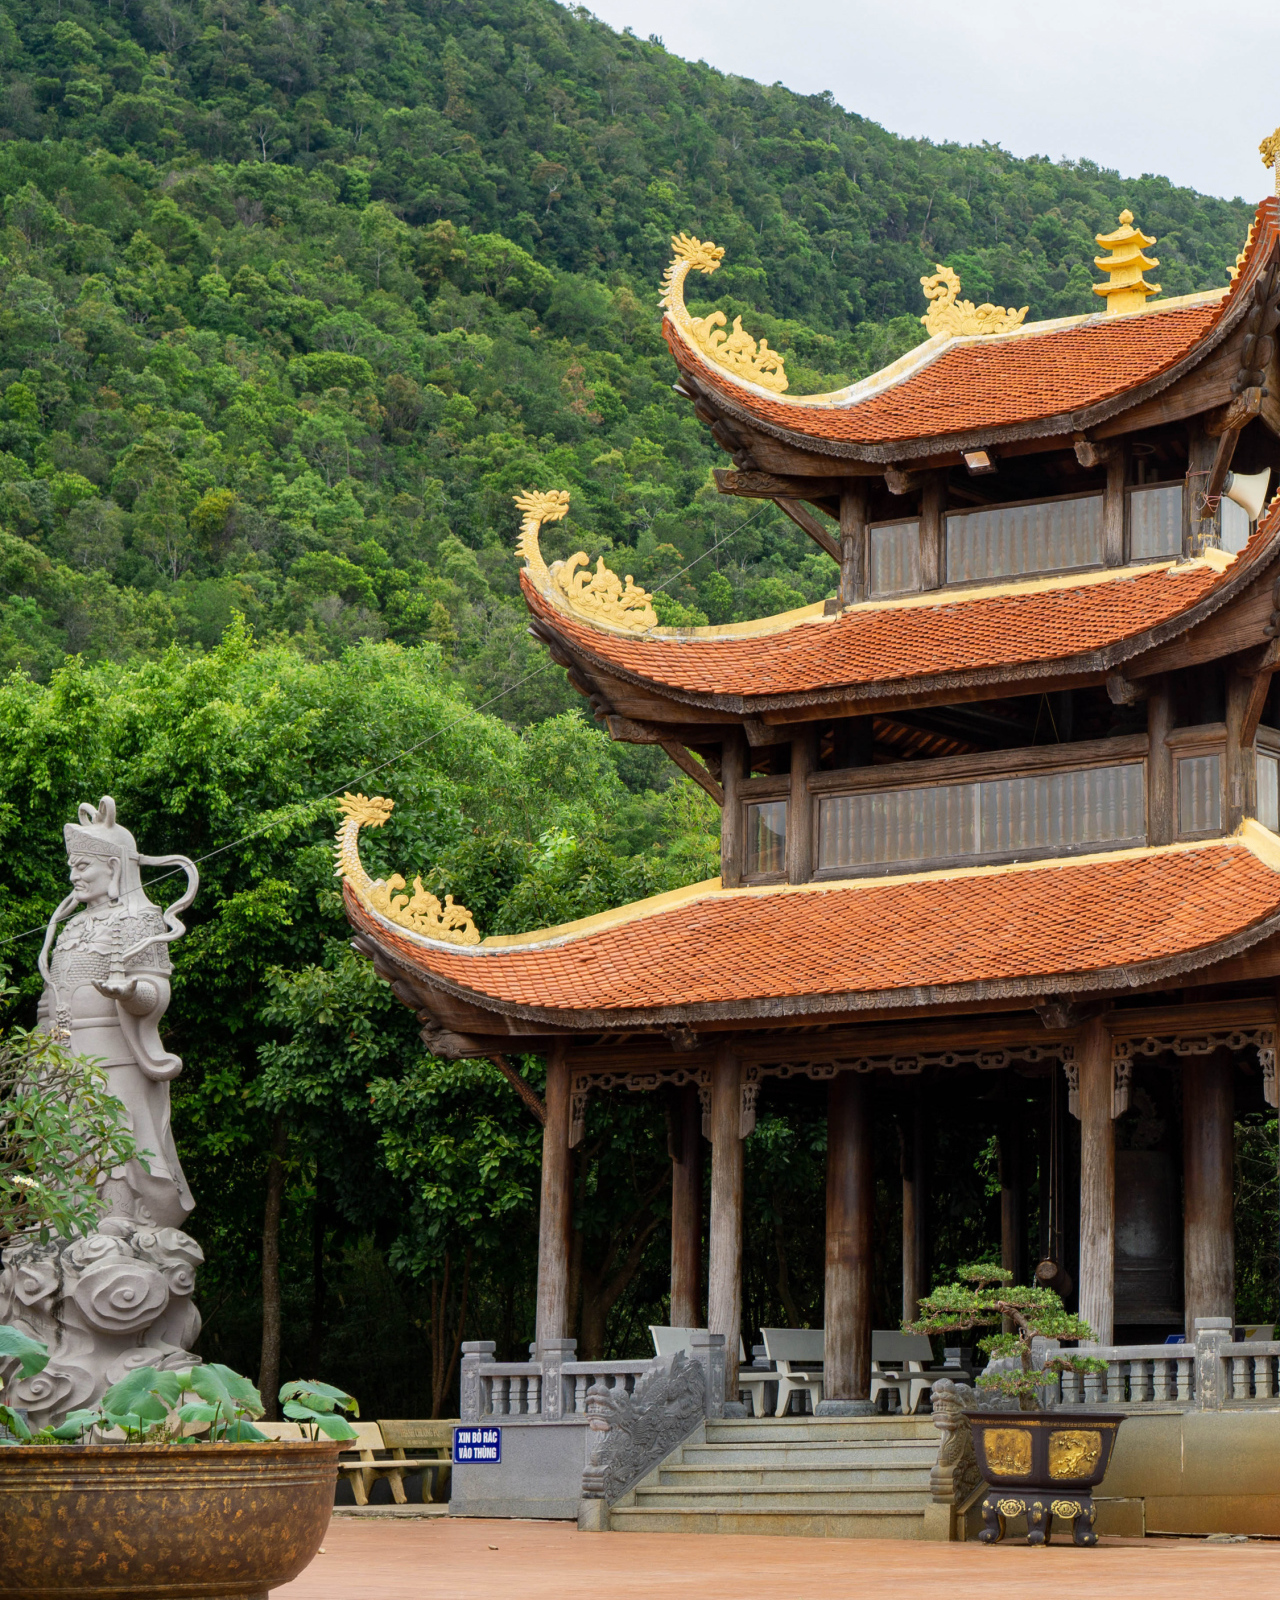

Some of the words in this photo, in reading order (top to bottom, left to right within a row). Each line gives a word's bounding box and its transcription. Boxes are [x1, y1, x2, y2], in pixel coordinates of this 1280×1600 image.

[458, 1431, 471, 1443] XIN
[472, 1428, 482, 1443] BỎ
[483, 1429, 498, 1443] RÁC
[458, 1445, 473, 1459] VÀO
[474, 1445, 497, 1459] THÙNG
